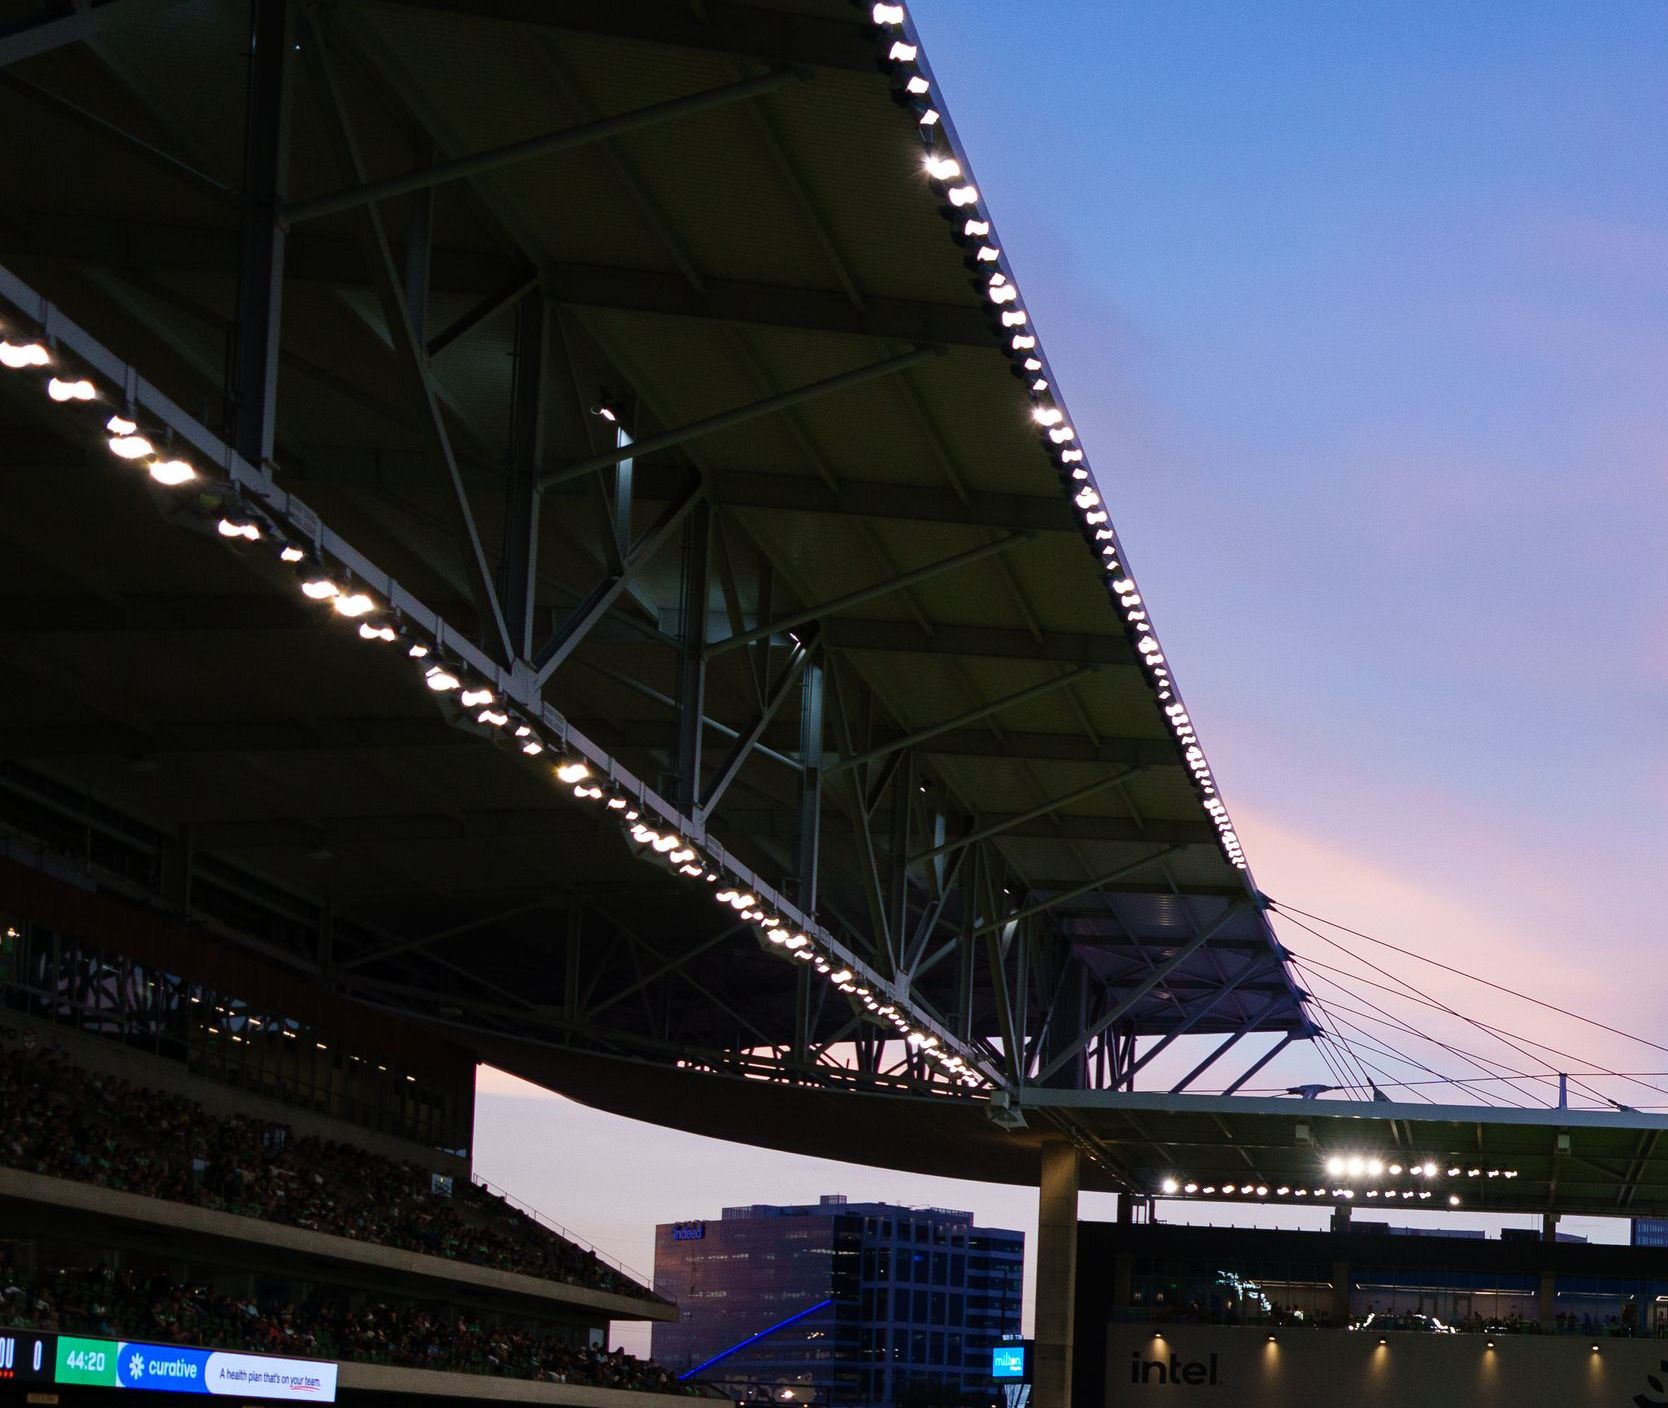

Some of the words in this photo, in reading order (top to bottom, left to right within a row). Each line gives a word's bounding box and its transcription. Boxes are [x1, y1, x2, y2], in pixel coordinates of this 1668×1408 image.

[66, 1350, 106, 1371] 44:20
[148, 1358, 198, 1379] curative
[1131, 1351, 1218, 1386] intel
[219, 1367, 225, 1378] A
[226, 1368, 247, 1381] health
[248, 1371, 263, 1384] plan
[263, 1372, 281, 1383] that's
[281, 1376, 290, 1384] on
[290, 1376, 305, 1388] your
[304, 1377, 321, 1388] team.
